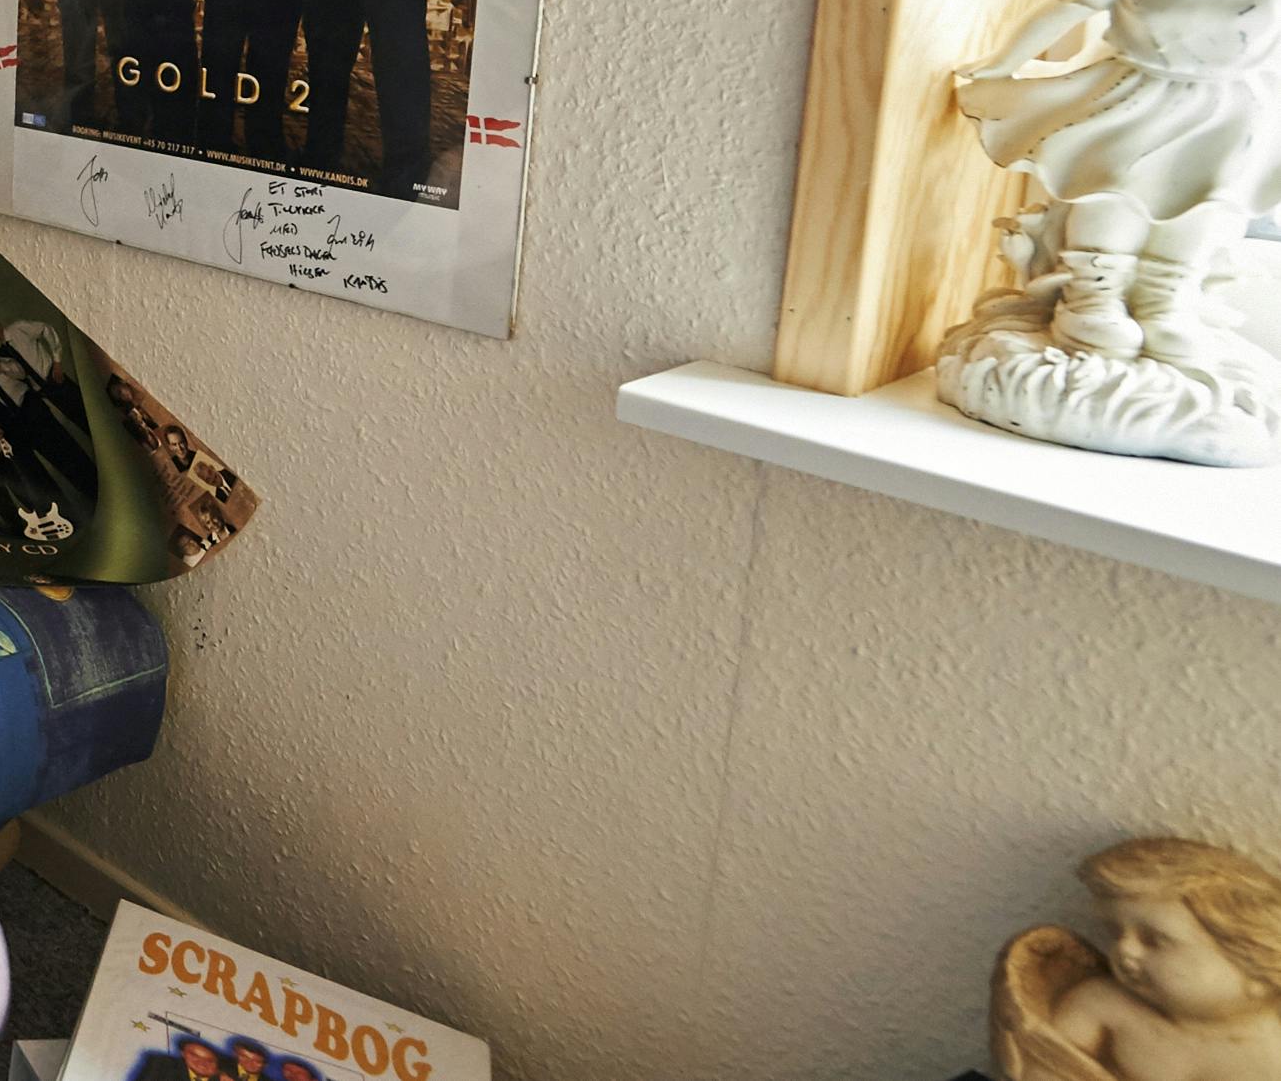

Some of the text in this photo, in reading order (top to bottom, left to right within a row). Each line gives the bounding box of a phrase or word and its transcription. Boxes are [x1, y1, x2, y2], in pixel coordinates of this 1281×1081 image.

[118, 55, 311, 113] GOLD 2
[103, 130, 142, 145] MUSIKEVENT
[157, 139, 166, 150] 70
[167, 141, 181, 153] 217
[206, 149, 287, 173] WWW.MUSIKEVENT.DK
[300, 167, 369, 188] WWW.KANDIS.DK
[268, 181, 287, 195] ET
[413, 183, 447, 196] MY WAY
[22, 543, 58, 557] CD
[138, 931, 433, 1081] SCRAPBOG
